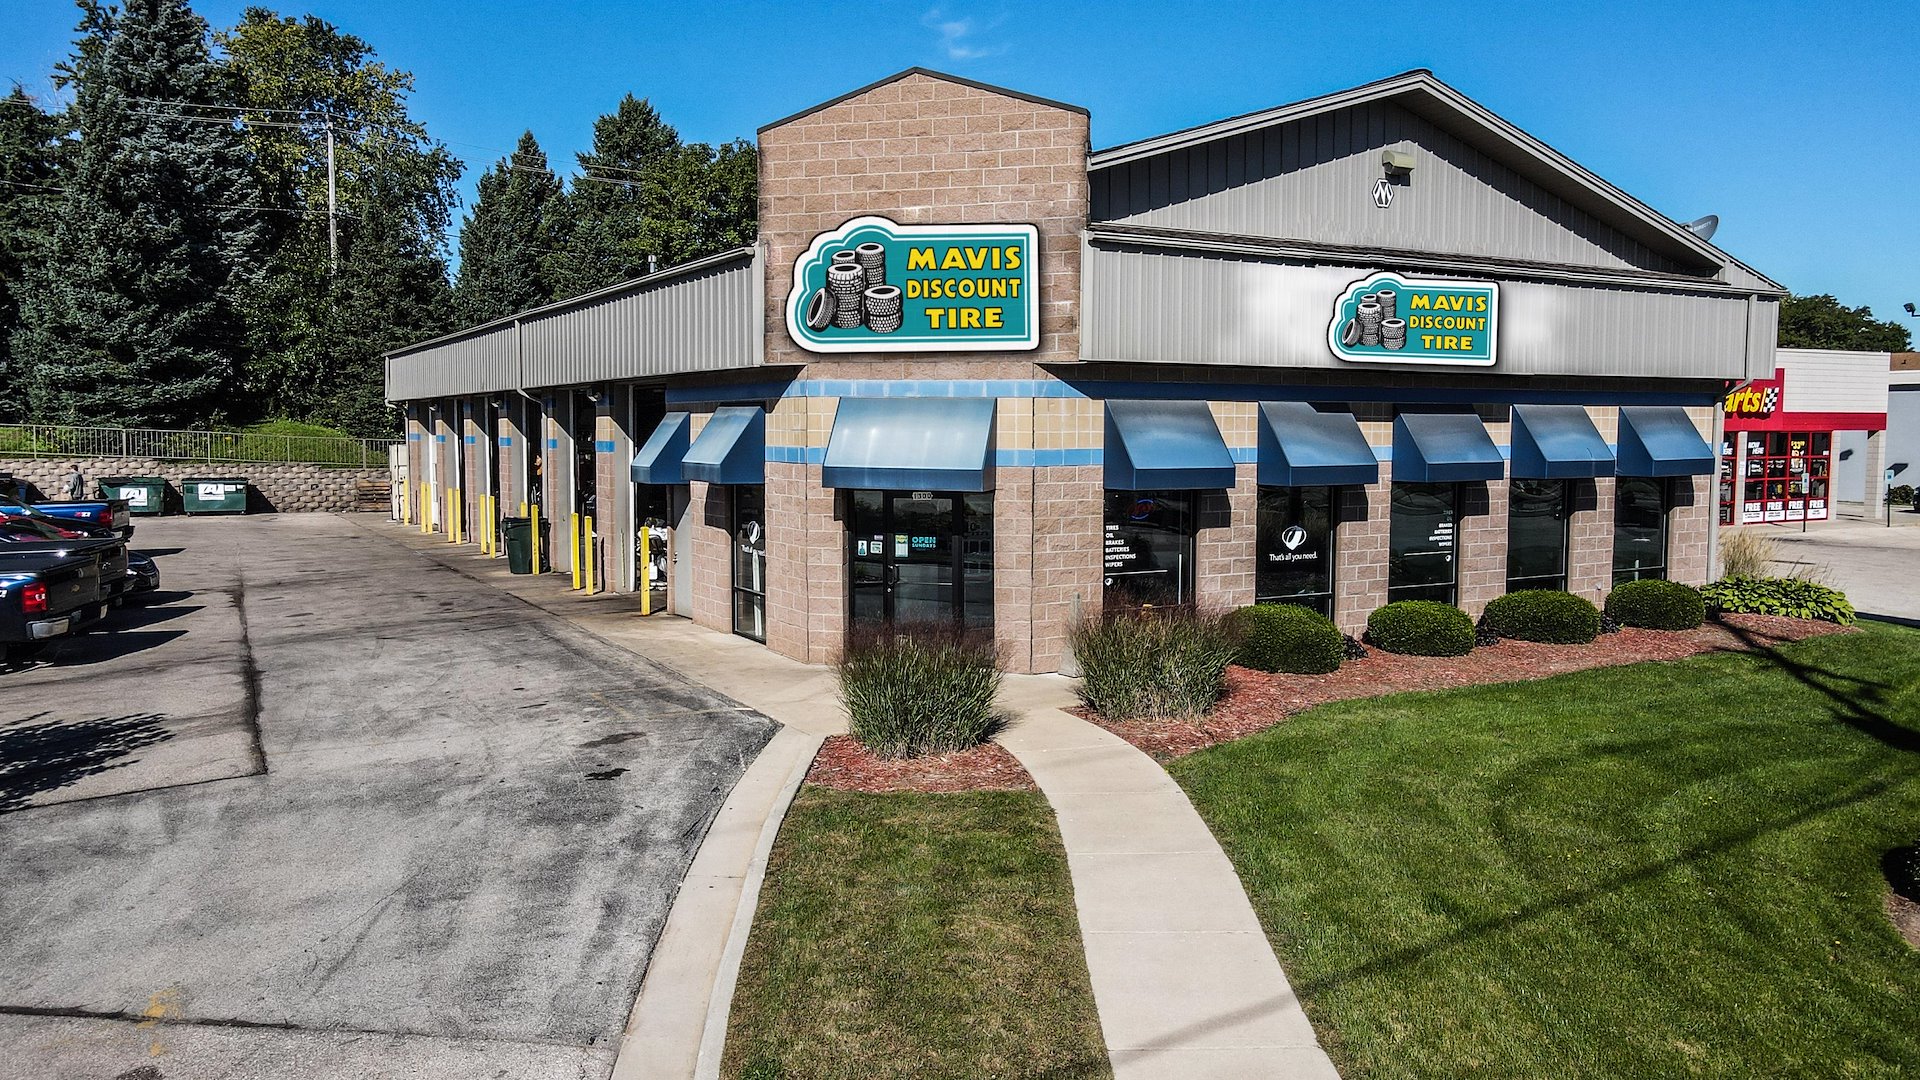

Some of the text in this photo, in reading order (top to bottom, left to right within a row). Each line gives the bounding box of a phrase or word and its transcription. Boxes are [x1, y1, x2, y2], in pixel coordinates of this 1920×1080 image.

[907, 246, 1022, 270] MAVIS
[907, 278, 1022, 299] DISCOUNT
[1410, 294, 1488, 312] MAVIS
[925, 307, 1005, 329] TIRE
[1409, 315, 1486, 331] DISCOUNT
[1421, 335, 1474, 351] TIRE
[1745, 502, 1761, 512] FREE
[1767, 501, 1783, 510] FREE
[1789, 500, 1804, 509] FREE
[1809, 499, 1825, 509] FREE
[1292, 554, 1302, 562] you
